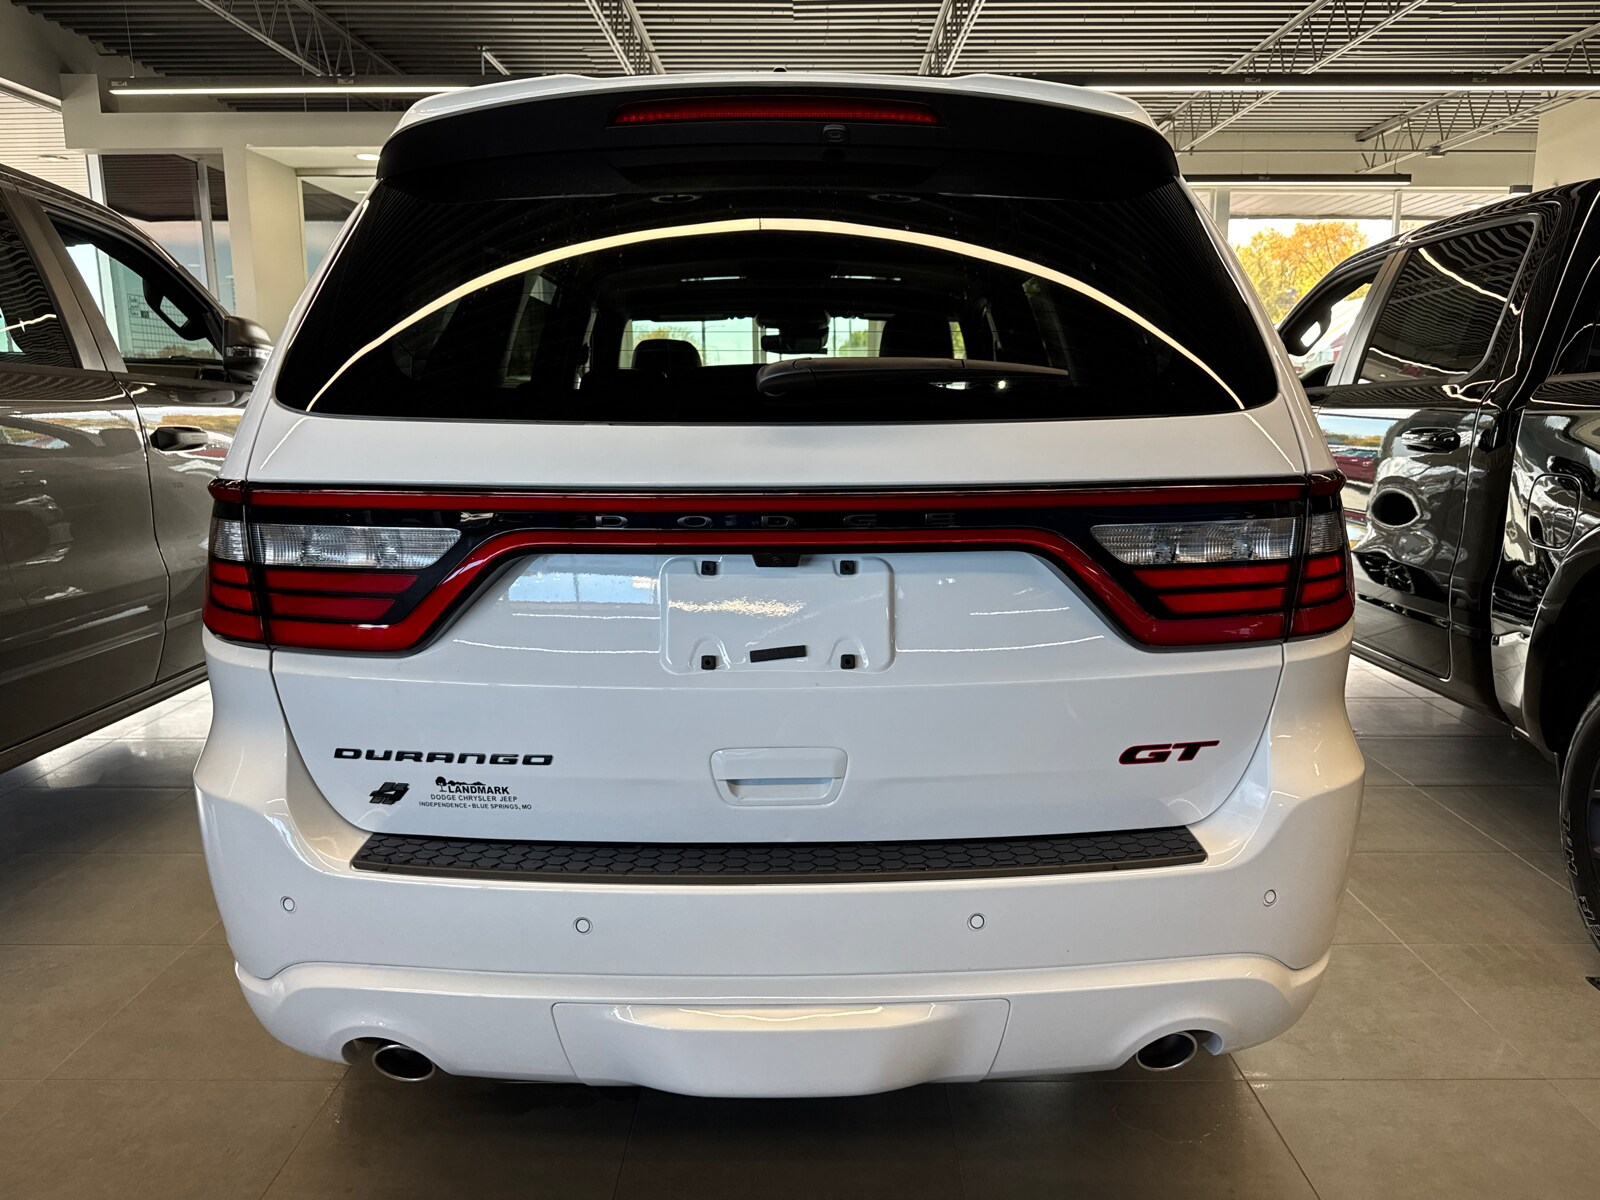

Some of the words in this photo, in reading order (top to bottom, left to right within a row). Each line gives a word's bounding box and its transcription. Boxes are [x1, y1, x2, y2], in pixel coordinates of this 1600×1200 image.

[594, 513, 957, 528] DODGE
[333, 747, 554, 766] DURANGO
[1118, 740, 1221, 765] GT
[447, 785, 510, 795] LANDMARK
